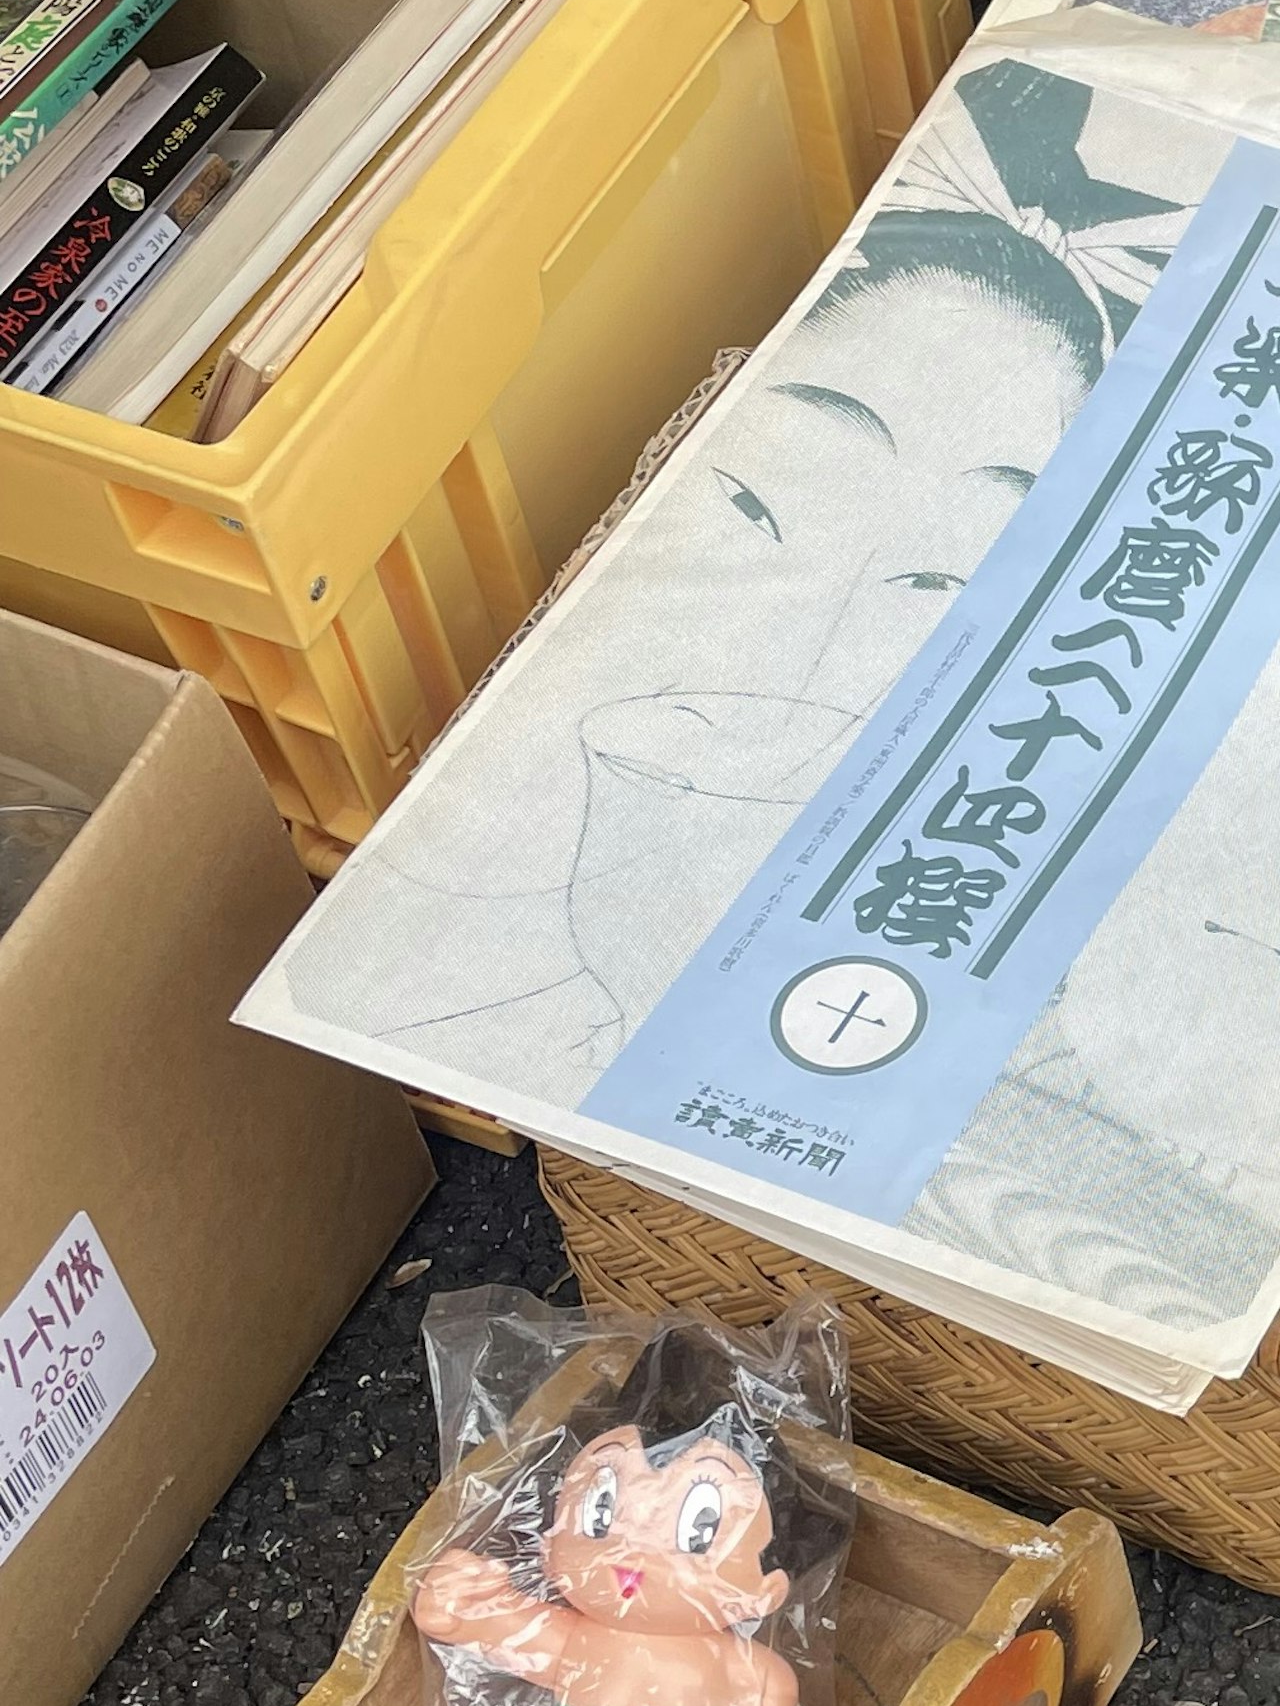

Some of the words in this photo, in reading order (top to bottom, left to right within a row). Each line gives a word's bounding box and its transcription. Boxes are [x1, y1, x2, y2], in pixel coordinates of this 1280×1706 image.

[145, 227, 170, 257] ME
[127, 253, 146, 274] NO
[107, 273, 130, 302] ME
